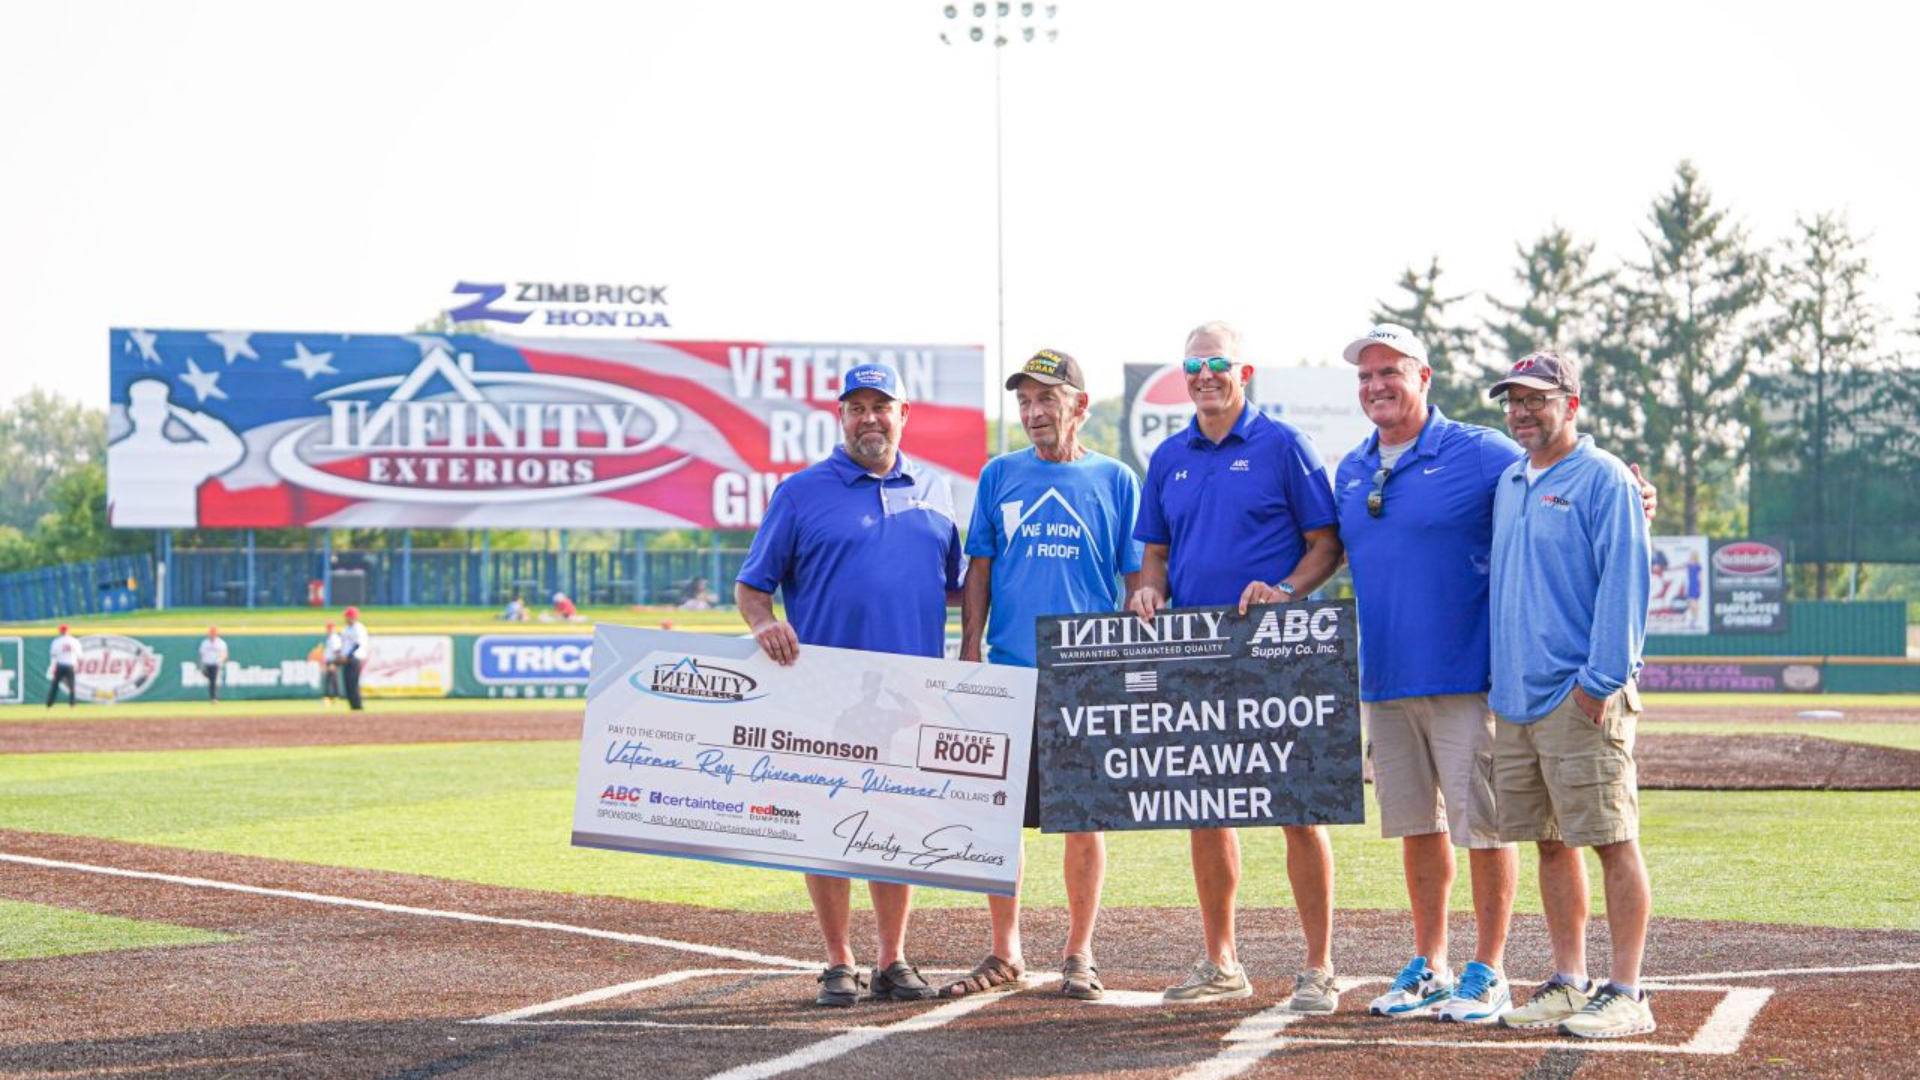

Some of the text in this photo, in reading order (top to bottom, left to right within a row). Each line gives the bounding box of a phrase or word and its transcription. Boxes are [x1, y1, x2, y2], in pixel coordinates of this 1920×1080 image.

[514, 282, 668, 305] ZIMBRICK
[544, 309, 671, 327] HONDA
[327, 400, 637, 450] INFINITY
[368, 456, 595, 485] EXTERIORS
[1021, 523, 1081, 539] WE WON
[1037, 543, 1080, 560] ROOF!
[1057, 611, 1226, 649] INFINITY
[1246, 607, 1343, 645] ABC
[490, 645, 592, 673] TRIC
[1060, 643, 1223, 660] WARRANTIED, GUARANTEED QUALITY
[1251, 643, 1337, 659] Supply Co. Inc.
[487, 686, 579, 698] INSUR
[1060, 694, 1336, 737] VETERAN ROOF
[608, 723, 697, 742] PAY TO THE ORDER OF
[732, 724, 879, 762] Bill Simonson
[938, 732, 993, 746] ONE FREE
[934, 740, 996, 766] ROOF
[1103, 741, 1295, 779] GIVEAWAY
[605, 740, 683, 770] Veteran
[750, 754, 849, 799] Giveaway
[861, 767, 951, 801] Winner!
[600, 784, 644, 803] ABC
[662, 795, 745, 814] certainteed
[950, 789, 990, 802] DOLLARS
[1128, 786, 1274, 822] WINNER
[749, 804, 801, 819] redbox+
[832, 810, 1006, 870] Infinity Exteriors
